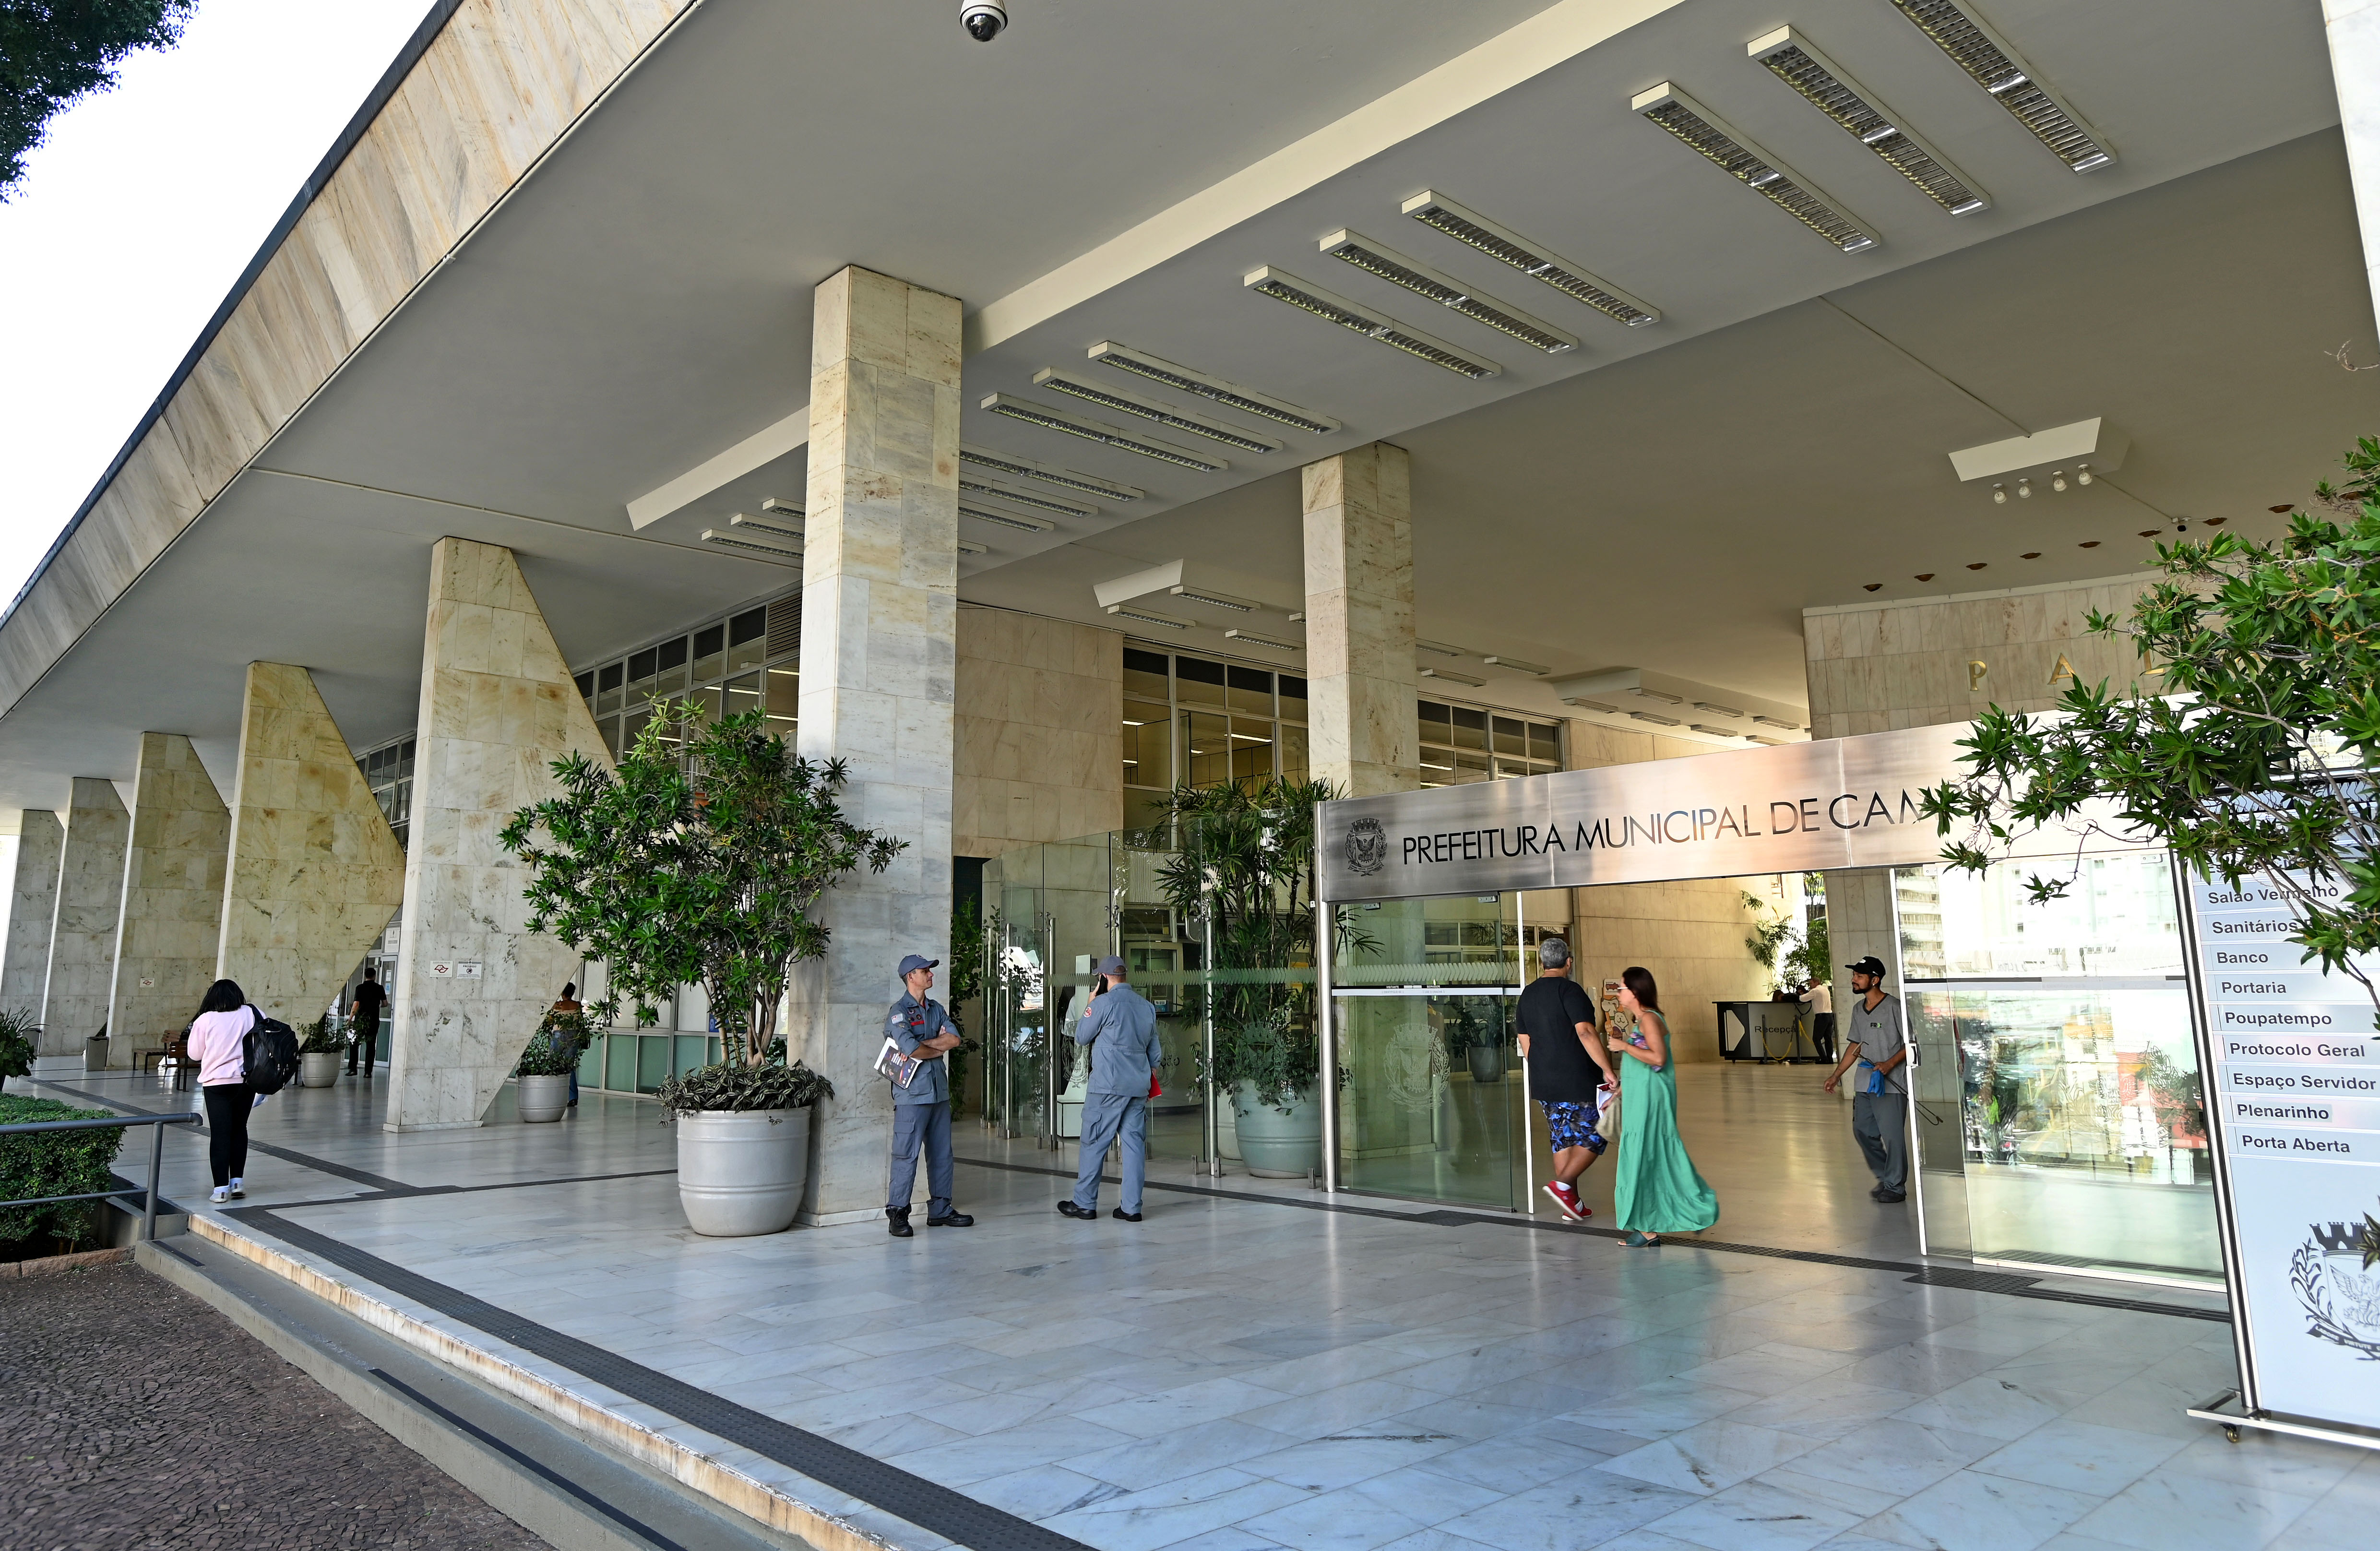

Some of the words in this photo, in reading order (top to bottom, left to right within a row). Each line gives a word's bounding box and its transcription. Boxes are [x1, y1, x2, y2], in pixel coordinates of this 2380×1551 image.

[1403, 822, 1566, 865] PREFEITURA
[1575, 805, 1761, 851] MUNICIPAL
[1770, 798, 1821, 835] DE
[2212, 919, 2297, 934] Sanitários
[2216, 952, 2269, 964] Banco
[2221, 981, 2287, 994] Portaria
[2225, 1012, 2332, 1027] Poupatempo
[2229, 1042, 2311, 1056] Protocolo
[2317, 1044, 2365, 1057] Geral
[2233, 1073, 2296, 1089] Espaço
[2301, 1075, 2377, 1090] Servidor
[2237, 1104, 2329, 1120] Plenarinho
[2242, 1135, 2287, 1149] Porta
[2293, 1138, 2350, 1153] Aberta
